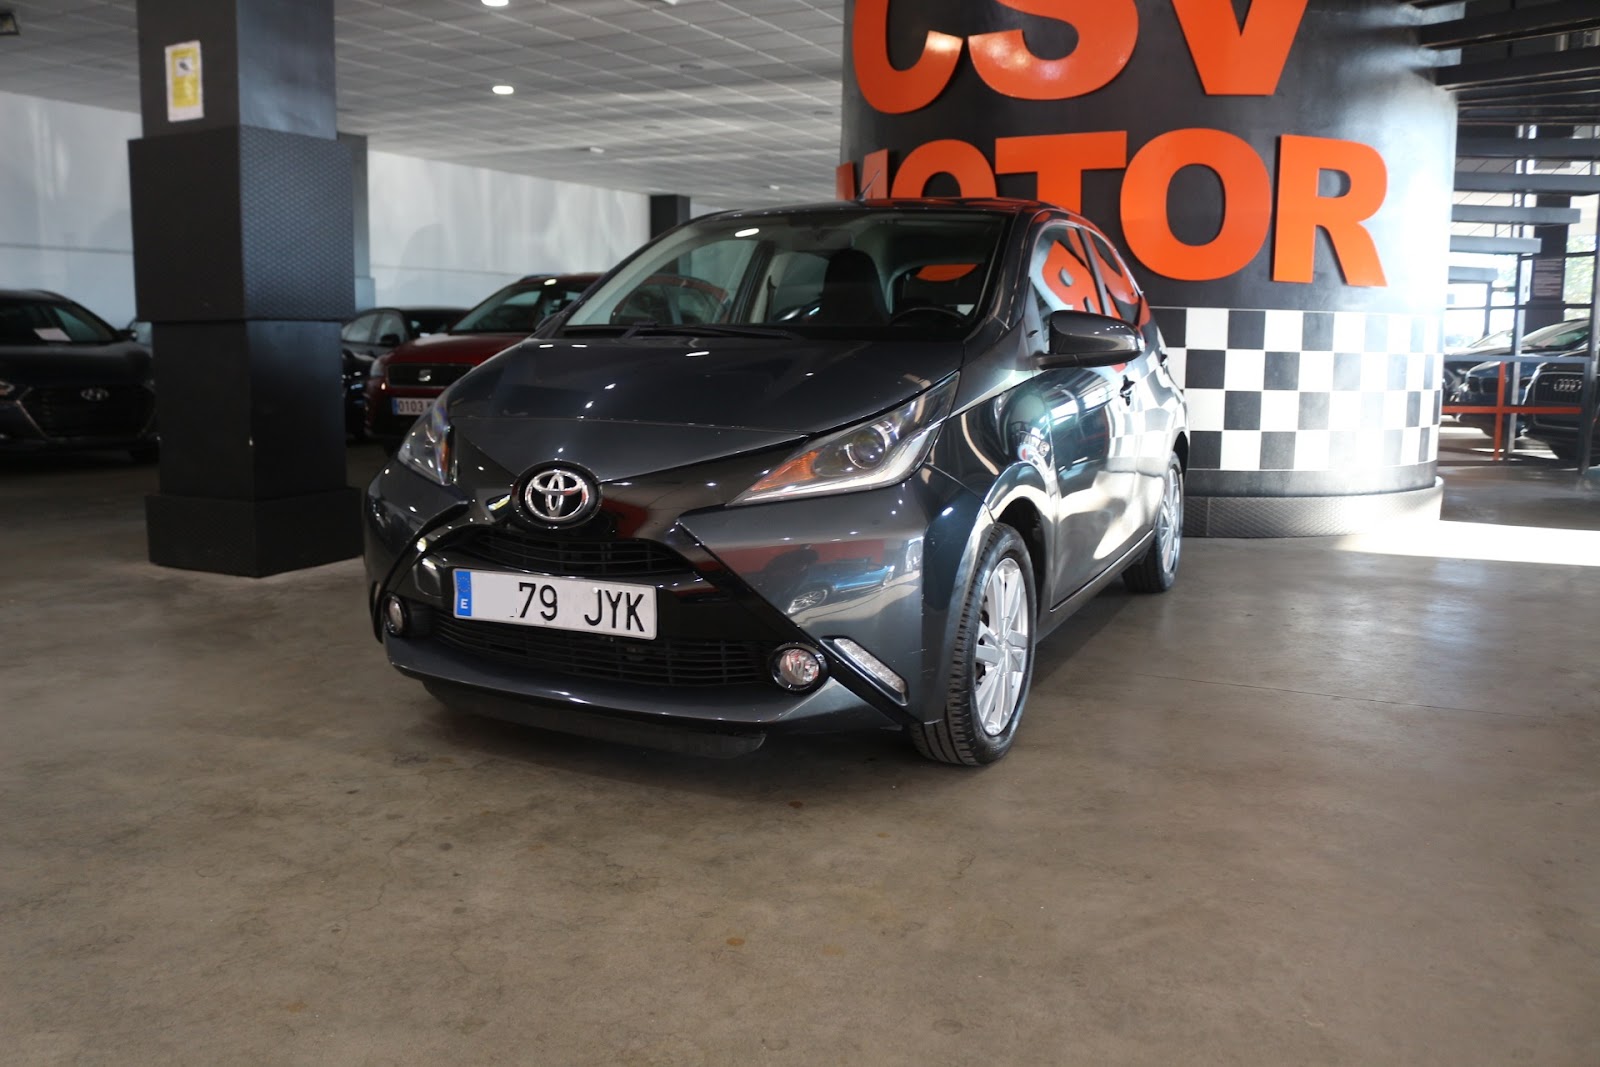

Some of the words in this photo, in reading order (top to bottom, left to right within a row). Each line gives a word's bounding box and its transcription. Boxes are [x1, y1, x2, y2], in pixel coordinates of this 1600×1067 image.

[852, 0, 1307, 114] CSV
[460, 598, 469, 610] E
[584, 589, 645, 633] JYK
